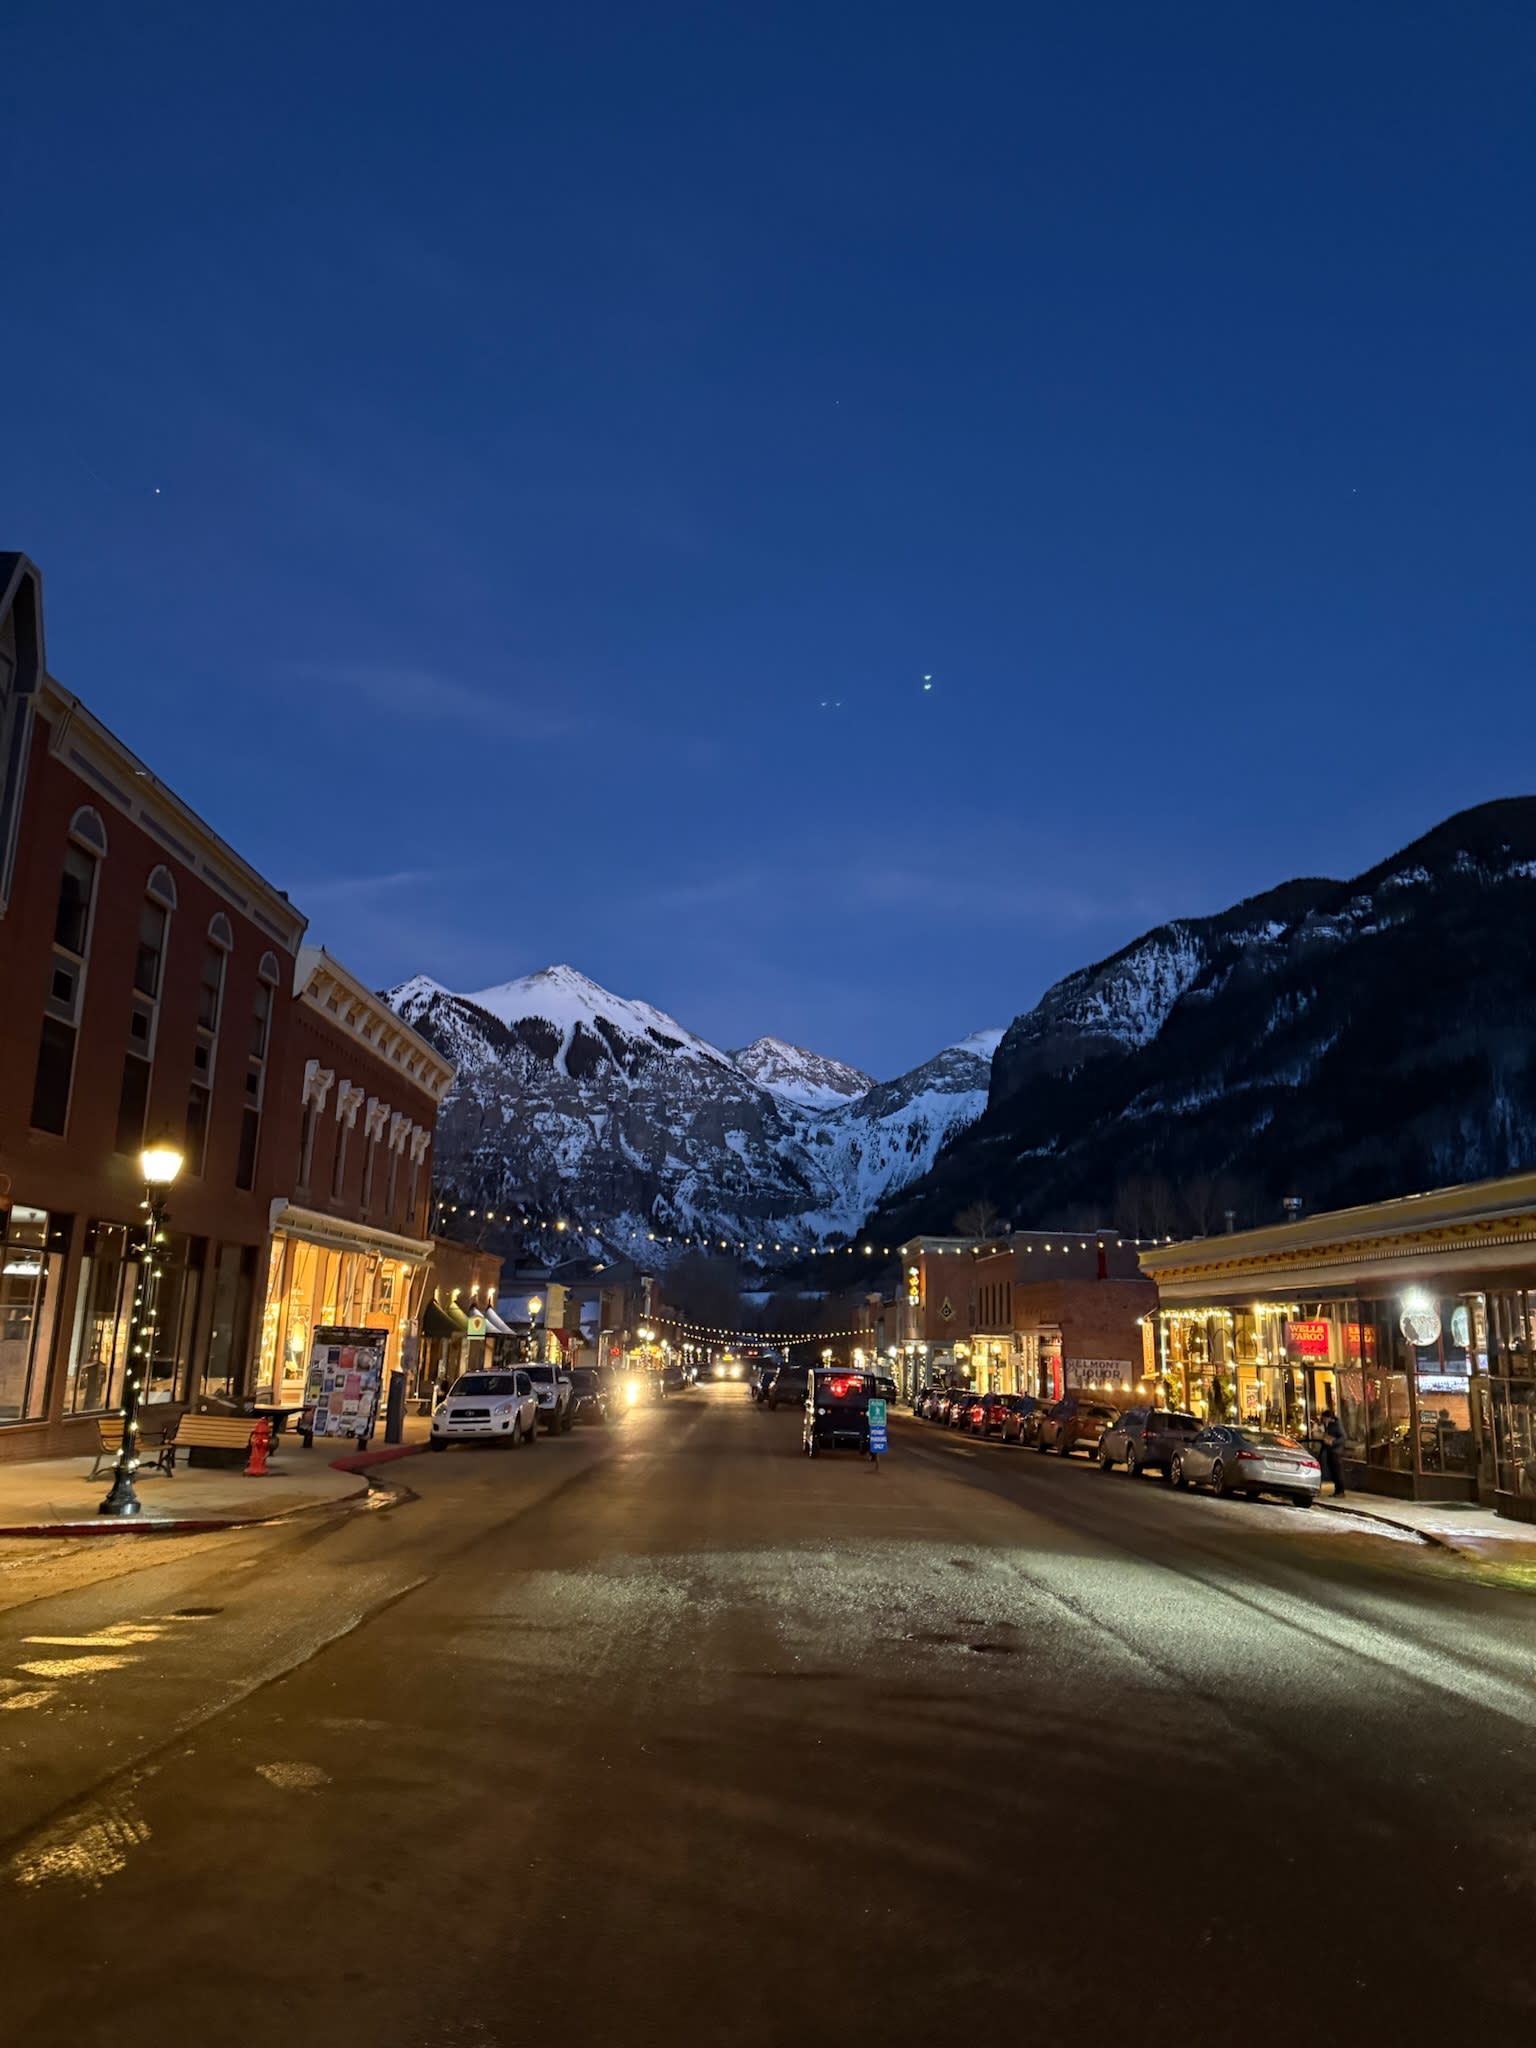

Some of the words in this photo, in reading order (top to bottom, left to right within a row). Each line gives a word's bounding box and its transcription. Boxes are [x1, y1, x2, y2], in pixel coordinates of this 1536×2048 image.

[1290, 1325, 1324, 1333] WELLS
[1291, 1333, 1324, 1341] FARGO
[1075, 1369, 1120, 1379] LIQUOR
